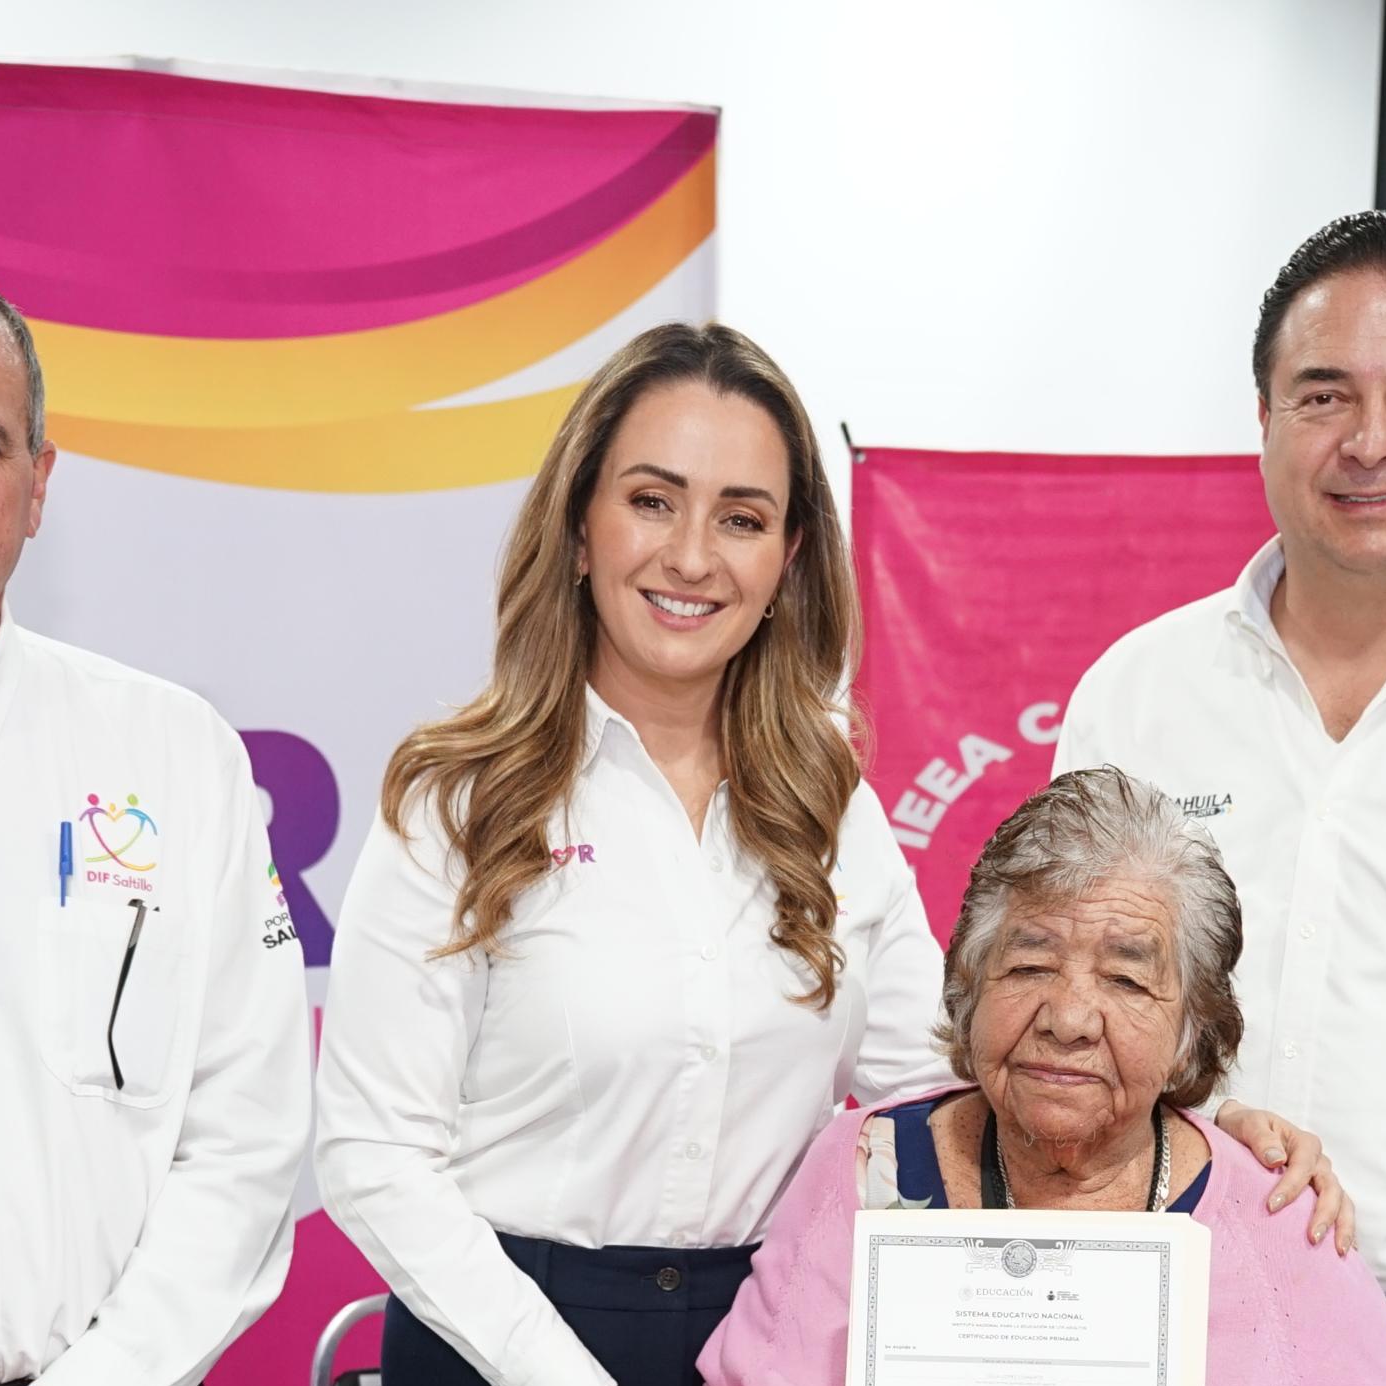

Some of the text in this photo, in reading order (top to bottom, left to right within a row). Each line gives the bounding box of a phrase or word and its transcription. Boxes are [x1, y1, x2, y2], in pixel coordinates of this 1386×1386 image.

[86, 870, 154, 893] DIF Saltillo
[955, 1310, 1085, 1321] SISTEMA EDUCATIVO NACIONAL
